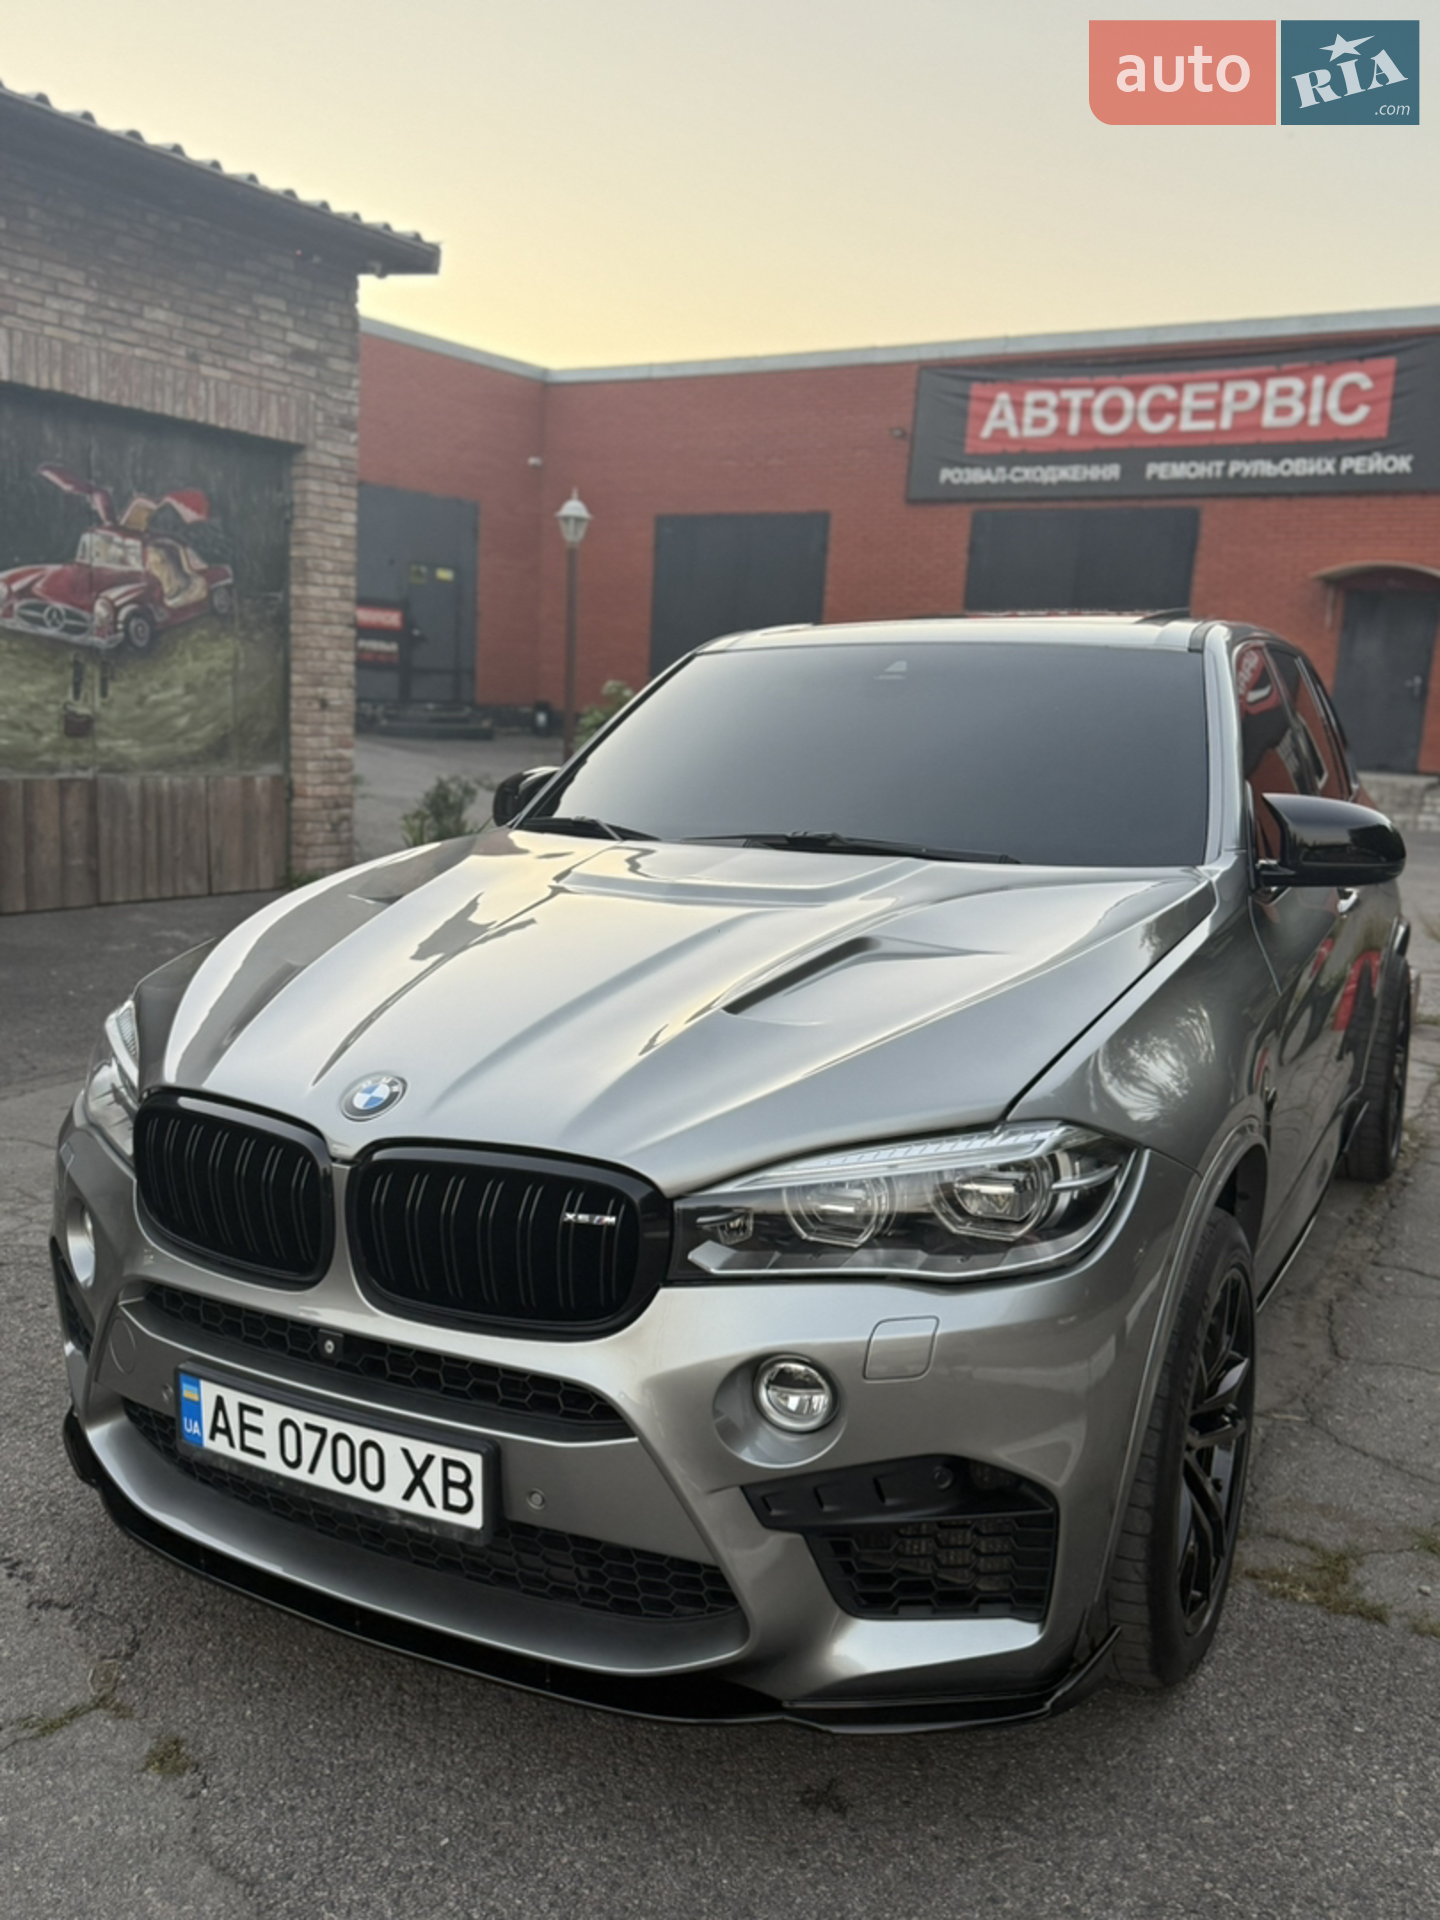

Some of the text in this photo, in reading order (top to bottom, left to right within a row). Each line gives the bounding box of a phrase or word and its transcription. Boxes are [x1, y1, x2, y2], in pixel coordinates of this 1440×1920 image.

[979, 371, 1375, 440] АВТОСЕРВІС
[1145, 452, 1414, 481] РЕМОНТ РУЛЬОВИХ РЕЙОК
[183, 1416, 202, 1438] UA
[208, 1394, 475, 1516] AE 0700 XB
